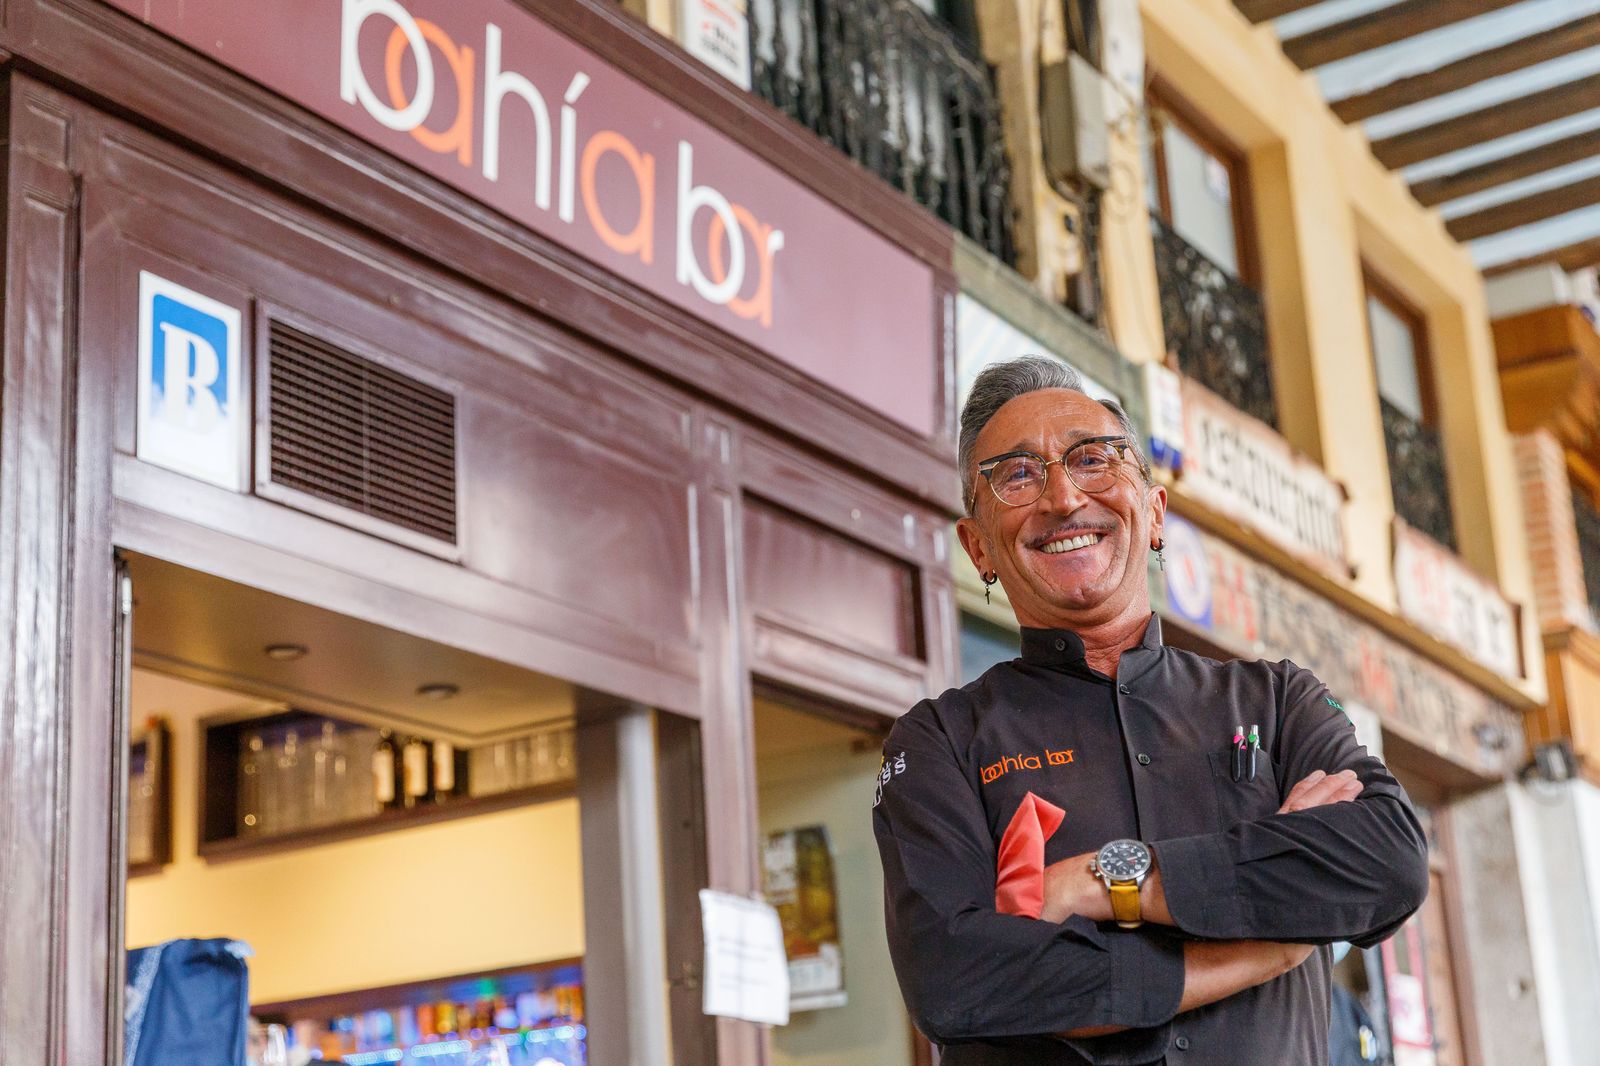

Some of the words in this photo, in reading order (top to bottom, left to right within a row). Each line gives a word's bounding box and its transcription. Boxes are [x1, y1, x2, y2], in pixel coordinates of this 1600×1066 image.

[340, 0, 656, 265] bahía
[676, 140, 784, 328] bar
[980, 753, 1042, 785] bahía
[1045, 749, 1074, 766] bar
